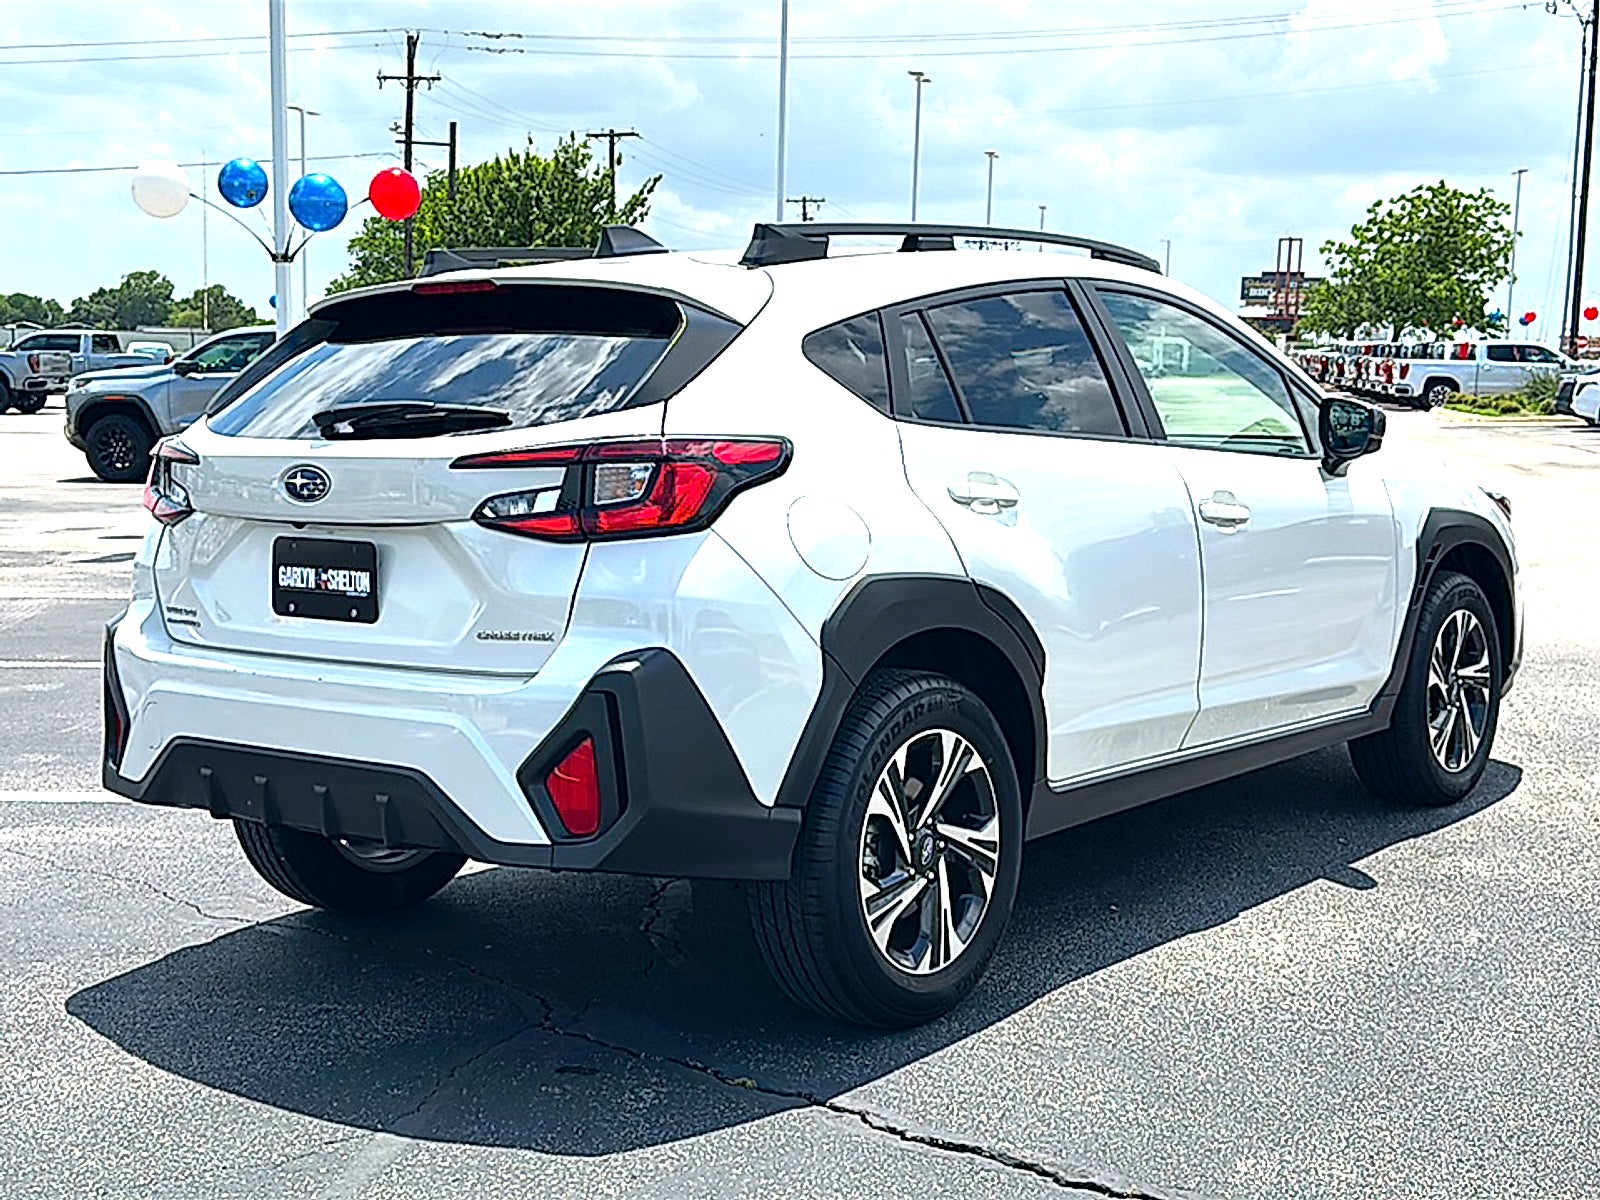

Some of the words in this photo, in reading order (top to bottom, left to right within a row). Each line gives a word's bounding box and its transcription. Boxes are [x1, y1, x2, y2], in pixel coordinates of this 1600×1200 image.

[278, 565, 316, 588] GARLYN
[327, 569, 370, 593] SHELTON
[476, 630, 556, 642] CROSSTREK
